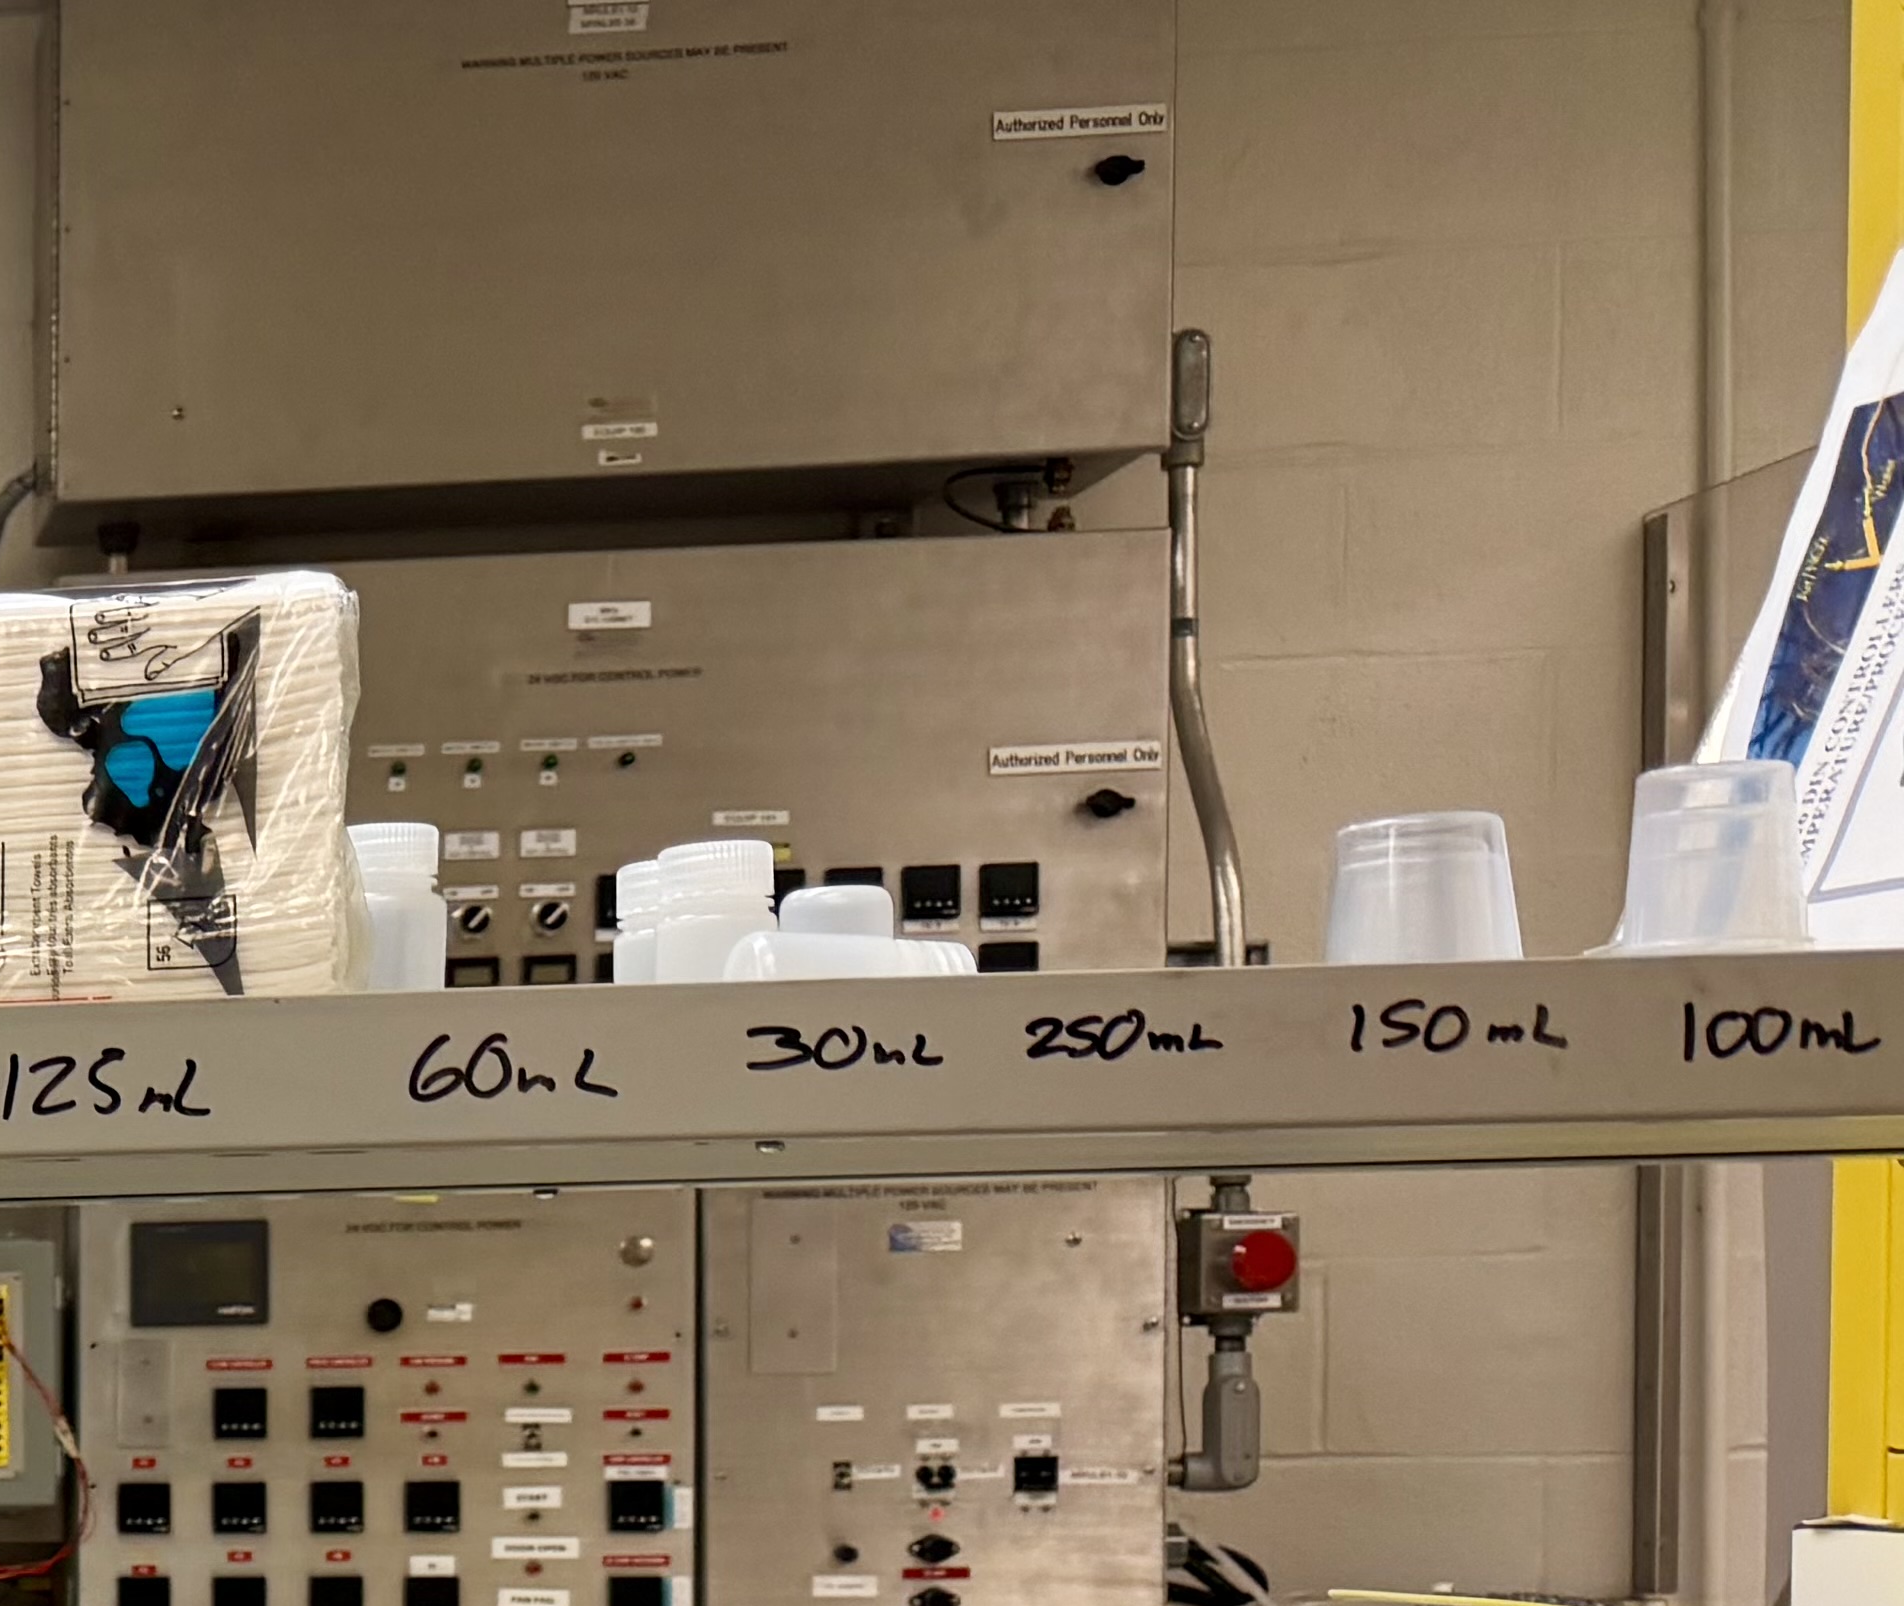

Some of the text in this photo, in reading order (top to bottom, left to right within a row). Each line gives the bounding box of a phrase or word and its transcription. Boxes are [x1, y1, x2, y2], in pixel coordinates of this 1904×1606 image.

[995, 109, 1166, 135] Authorized Personnel Only
[990, 745, 1161, 770] Authorized Personnel Only
